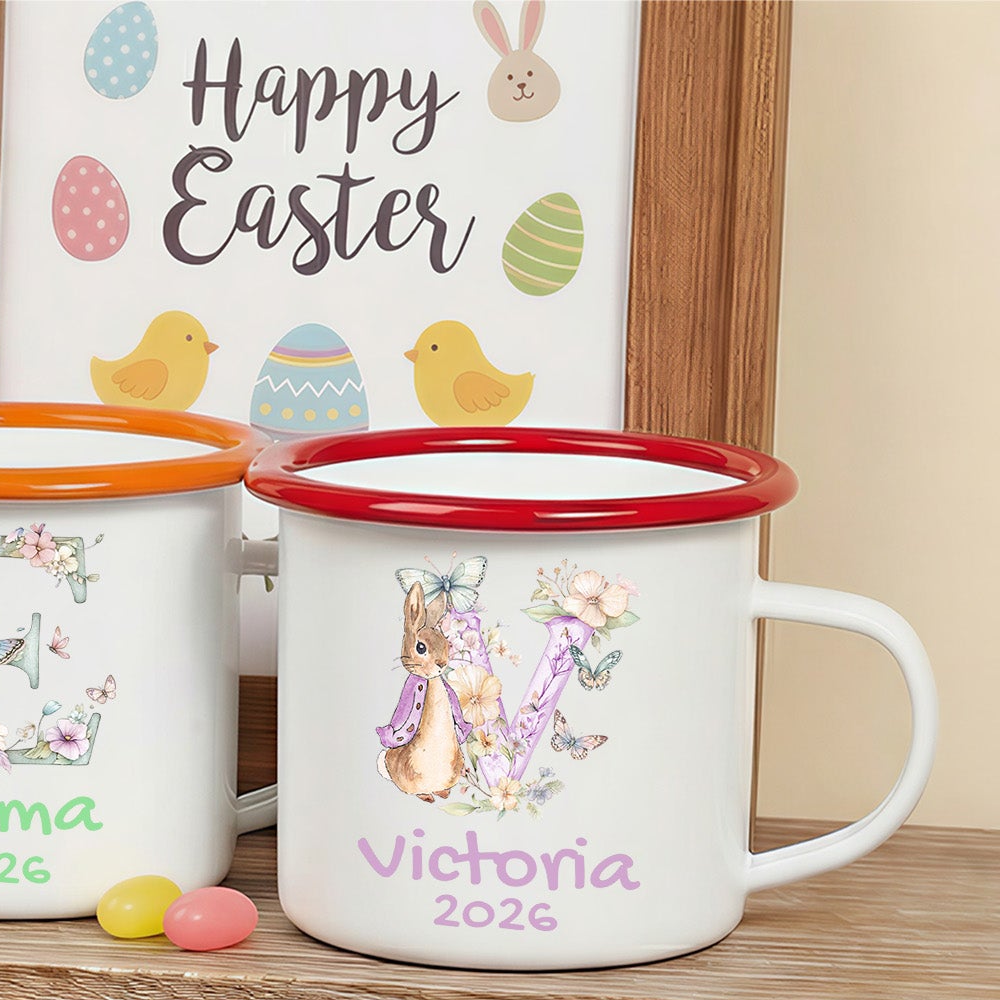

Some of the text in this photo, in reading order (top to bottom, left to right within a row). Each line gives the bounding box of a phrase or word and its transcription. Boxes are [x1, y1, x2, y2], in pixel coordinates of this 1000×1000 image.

[182, 37, 460, 155] Happy
[162, 144, 476, 276] Easter
[356, 828, 641, 891] Victoria
[433, 894, 559, 931] 2026
